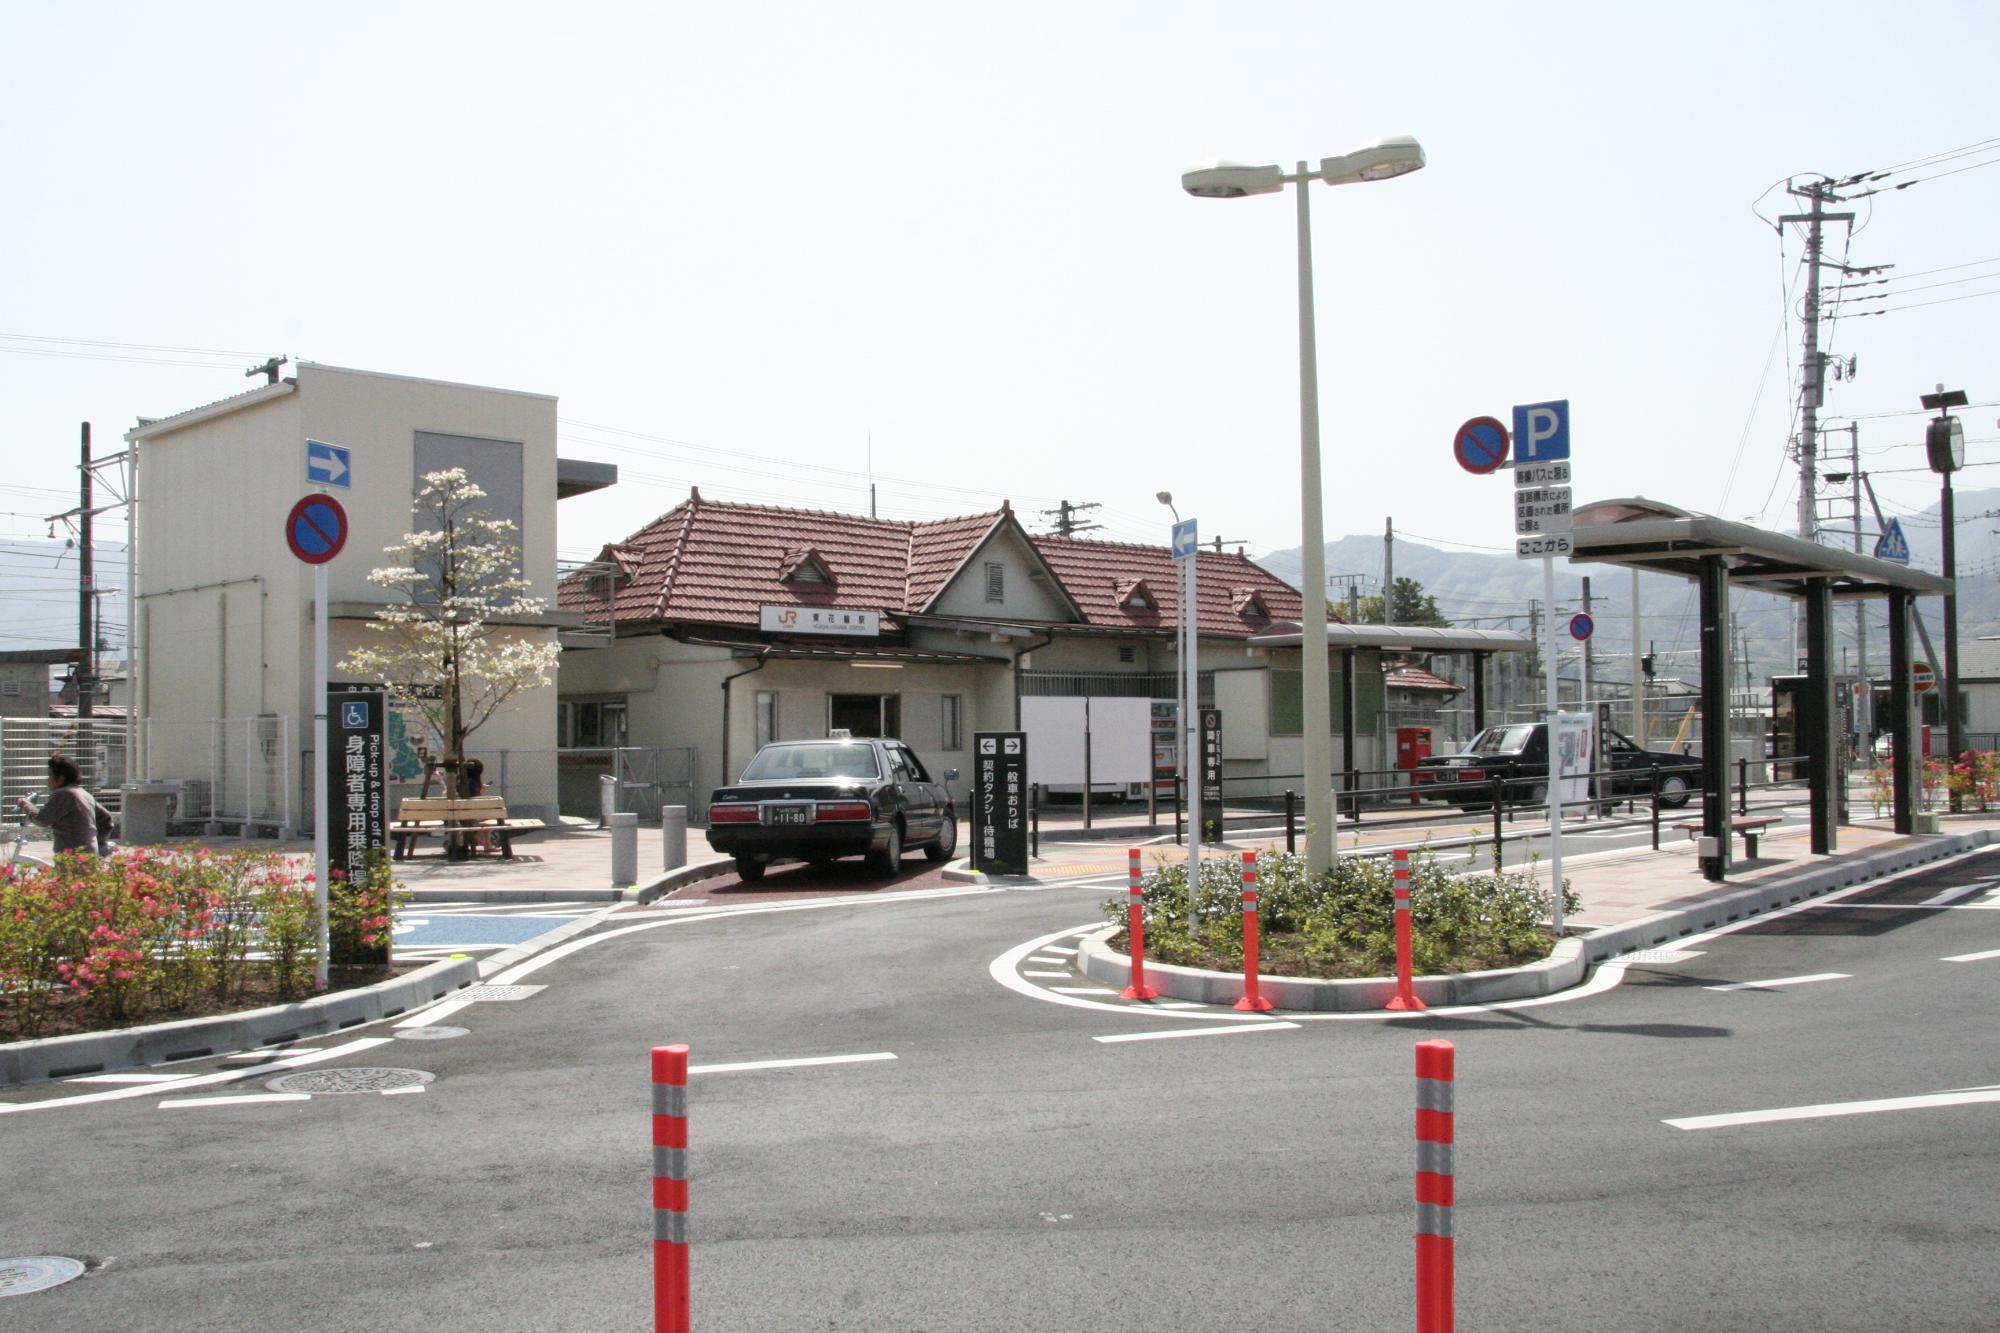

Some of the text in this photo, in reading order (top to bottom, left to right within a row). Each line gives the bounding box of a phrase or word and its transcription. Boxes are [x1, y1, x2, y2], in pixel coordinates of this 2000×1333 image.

[1527, 408, 1559, 457] P
[1518, 519, 1540, 532] に限る
[1519, 538, 1569, 555] ここから
[778, 610, 798, 625] JR
[369, 734, 380, 778] Pick-up
[370, 780, 381, 789] &
[369, 791, 381, 818] drop
[1007, 763, 1018, 829] 一般車おりば
[983, 760, 995, 859] 契約タクシー待機場
[371, 820, 381, 836] off
